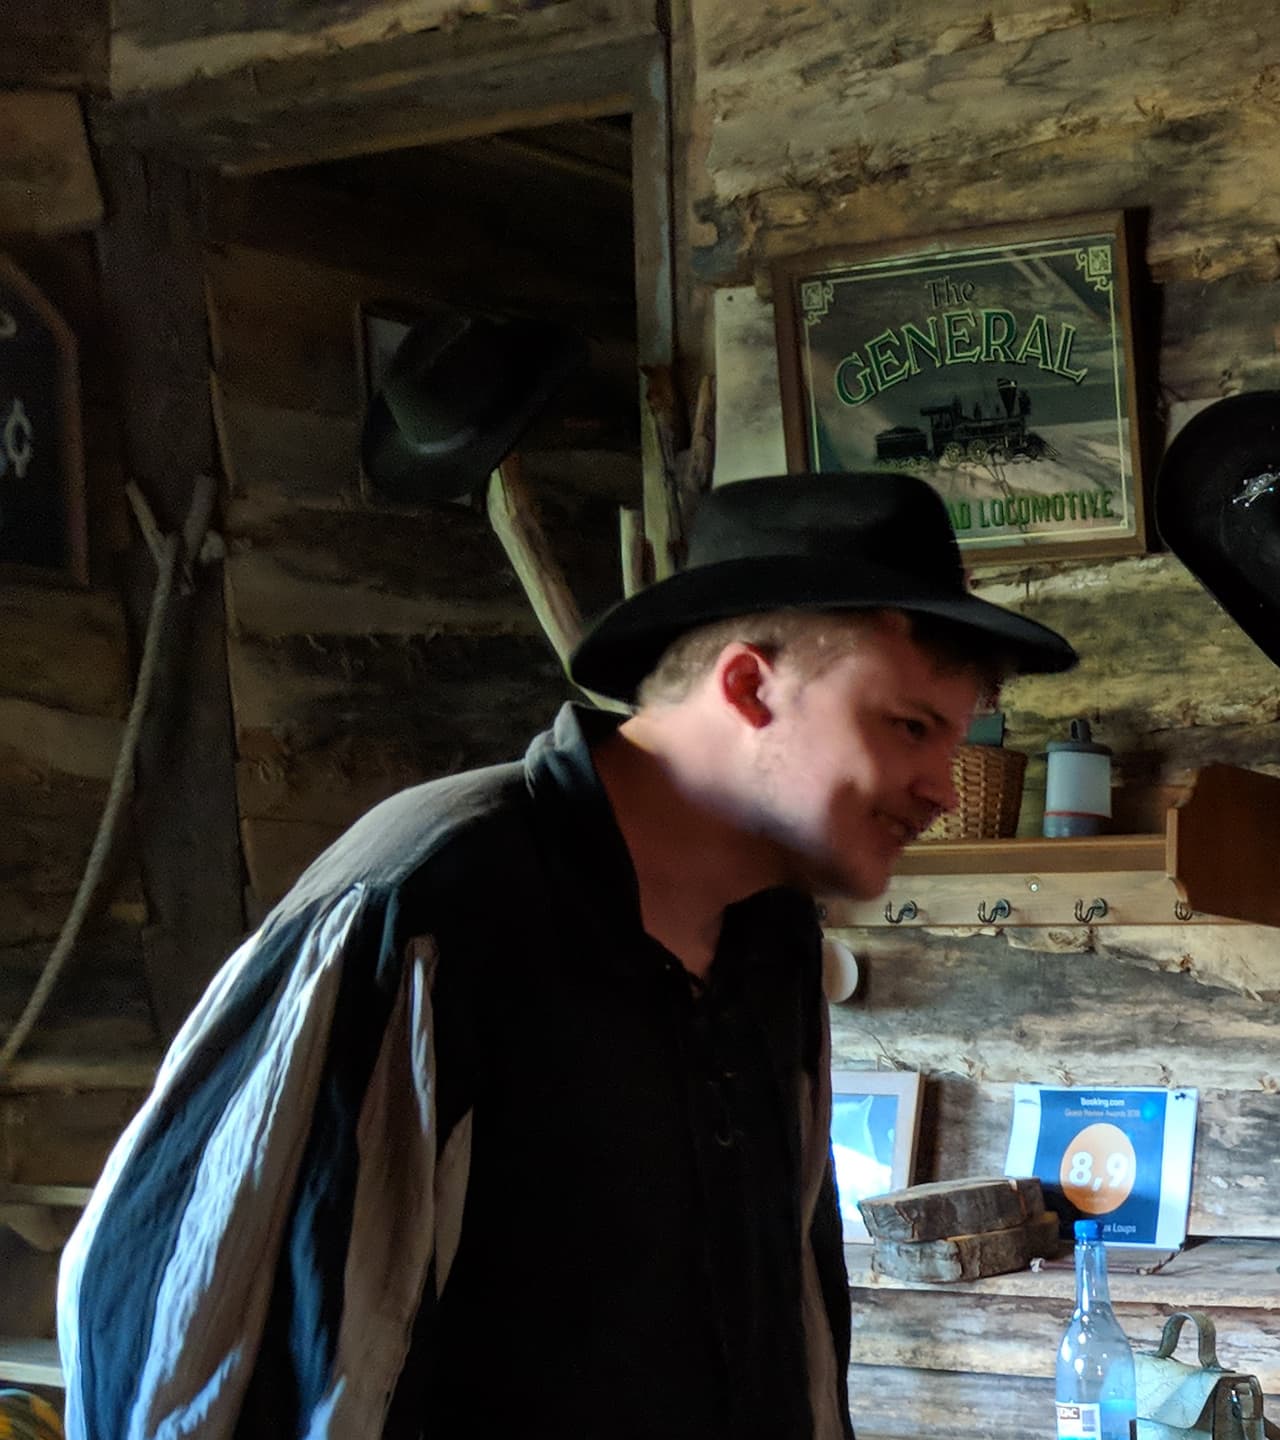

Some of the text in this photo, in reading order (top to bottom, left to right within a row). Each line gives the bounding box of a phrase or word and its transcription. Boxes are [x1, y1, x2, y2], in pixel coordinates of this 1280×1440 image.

[925, 277, 976, 308] The
[836, 308, 1088, 406] GENERAL
[980, 490, 1114, 528] LOCOMOTIVE
[1080, 1097, 1125, 1108] Booking.com
[1069, 1151, 1129, 1191] 8,9
[1112, 1222, 1136, 1234] Loups
